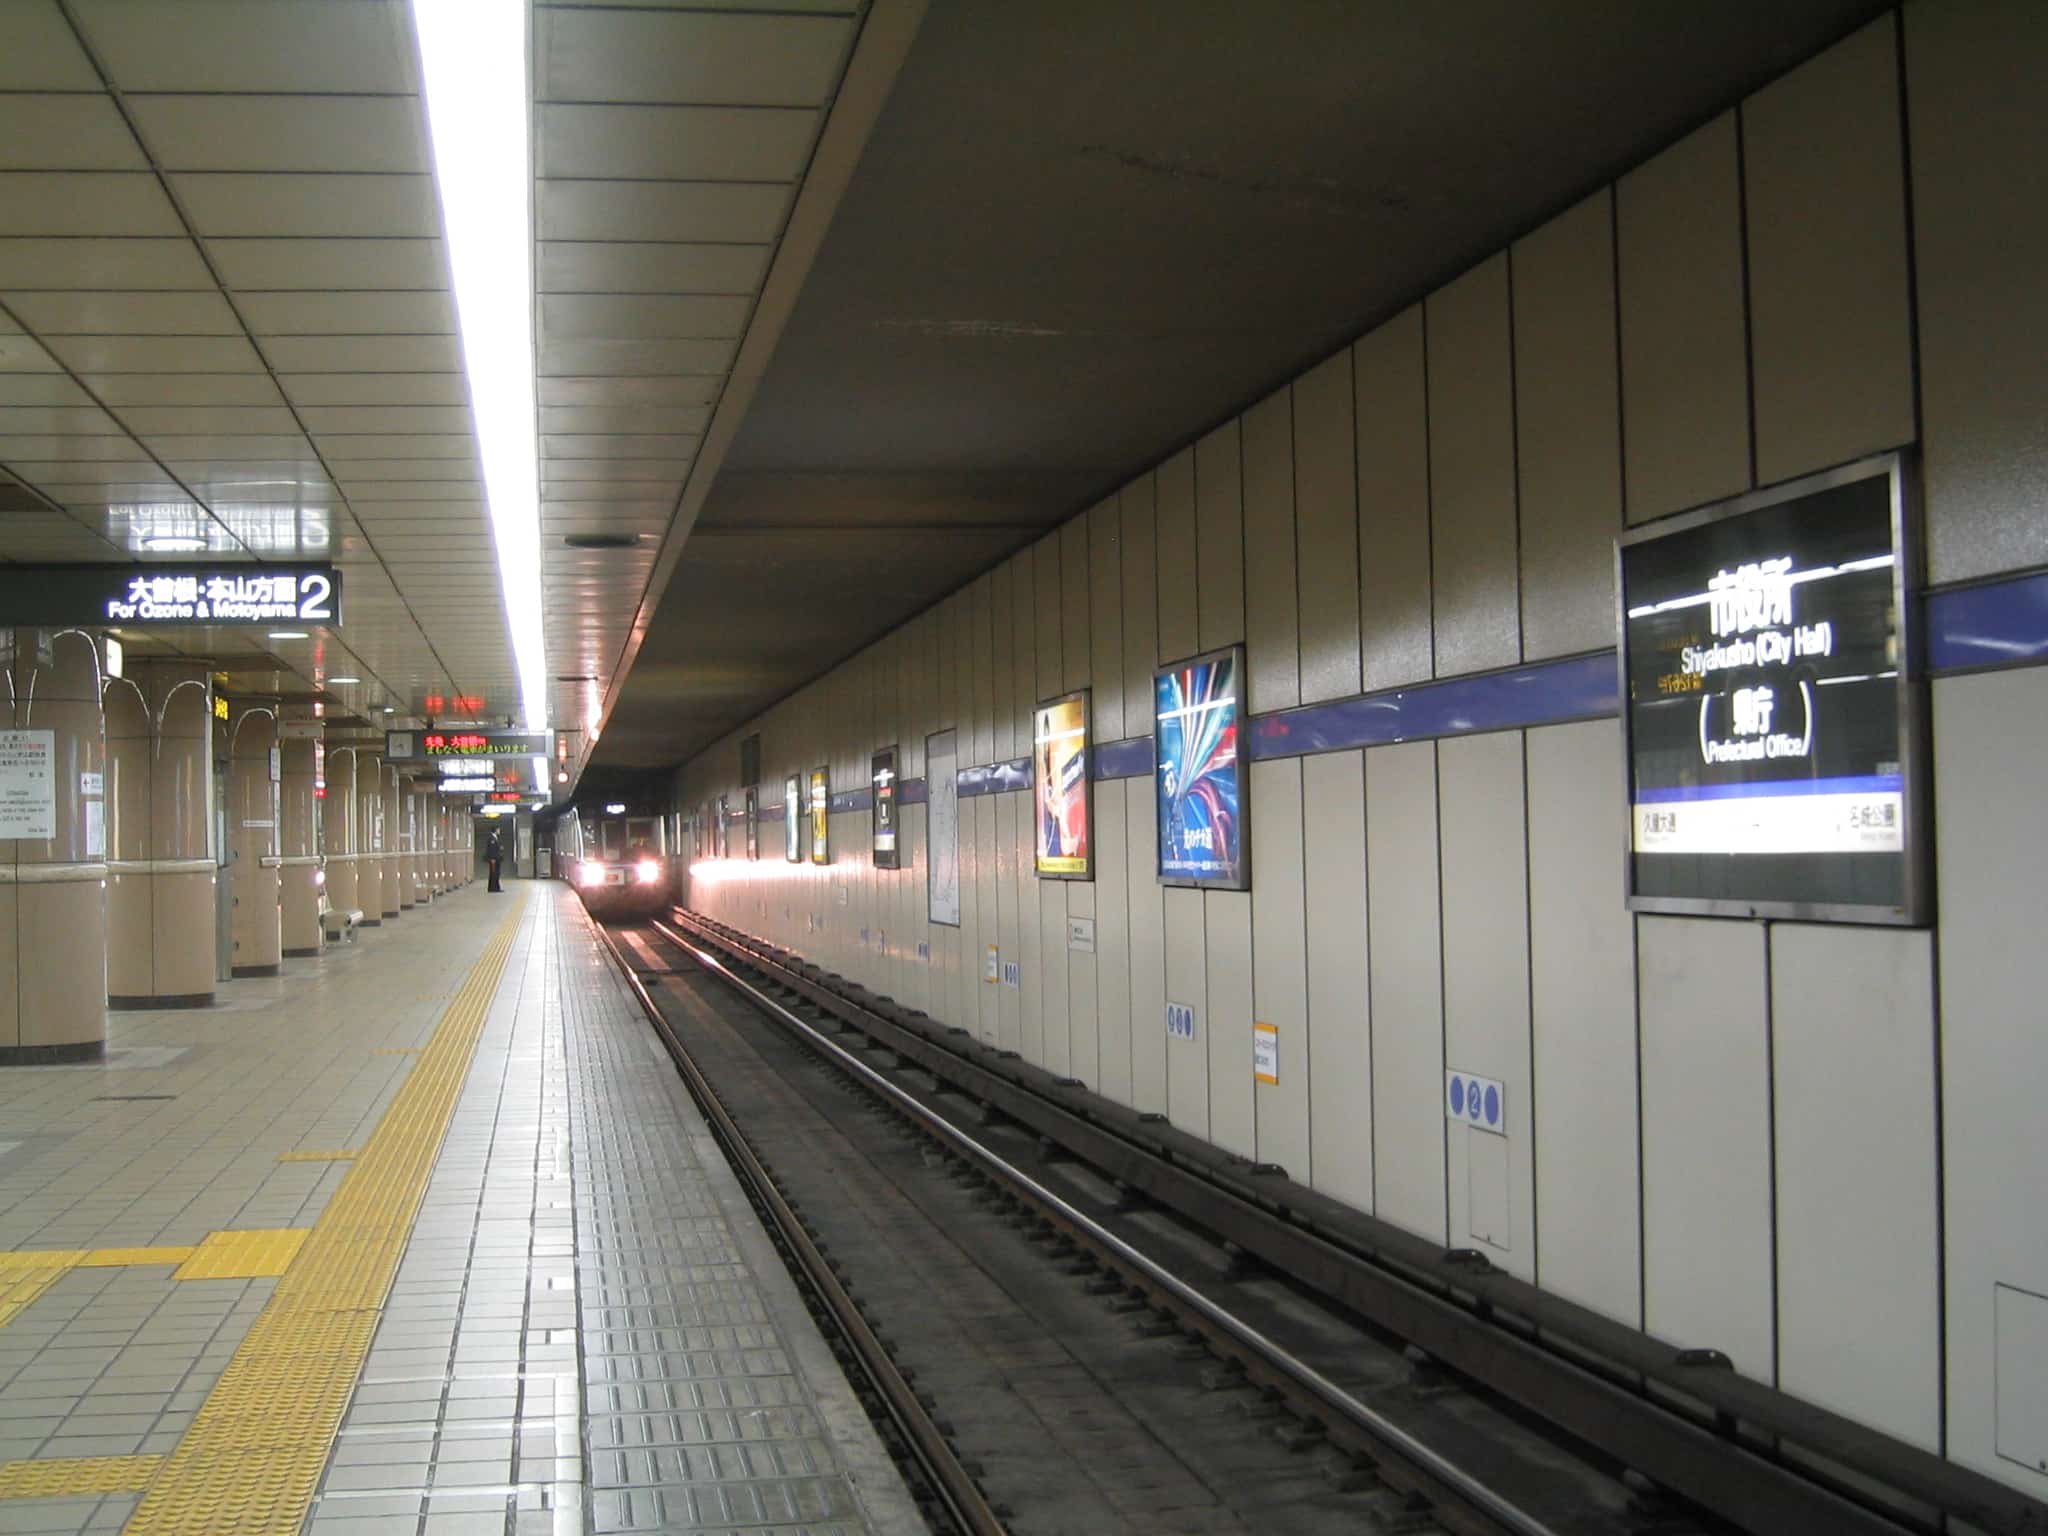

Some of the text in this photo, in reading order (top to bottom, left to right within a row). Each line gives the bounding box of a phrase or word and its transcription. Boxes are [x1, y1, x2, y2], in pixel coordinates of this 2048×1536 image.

[108, 601, 296, 621] For Ozone & Motoyama
[301, 575, 331, 618] 2
[1681, 621, 1832, 677] Shiyakusho (City Hall)
[1766, 733, 1802, 758] Office
